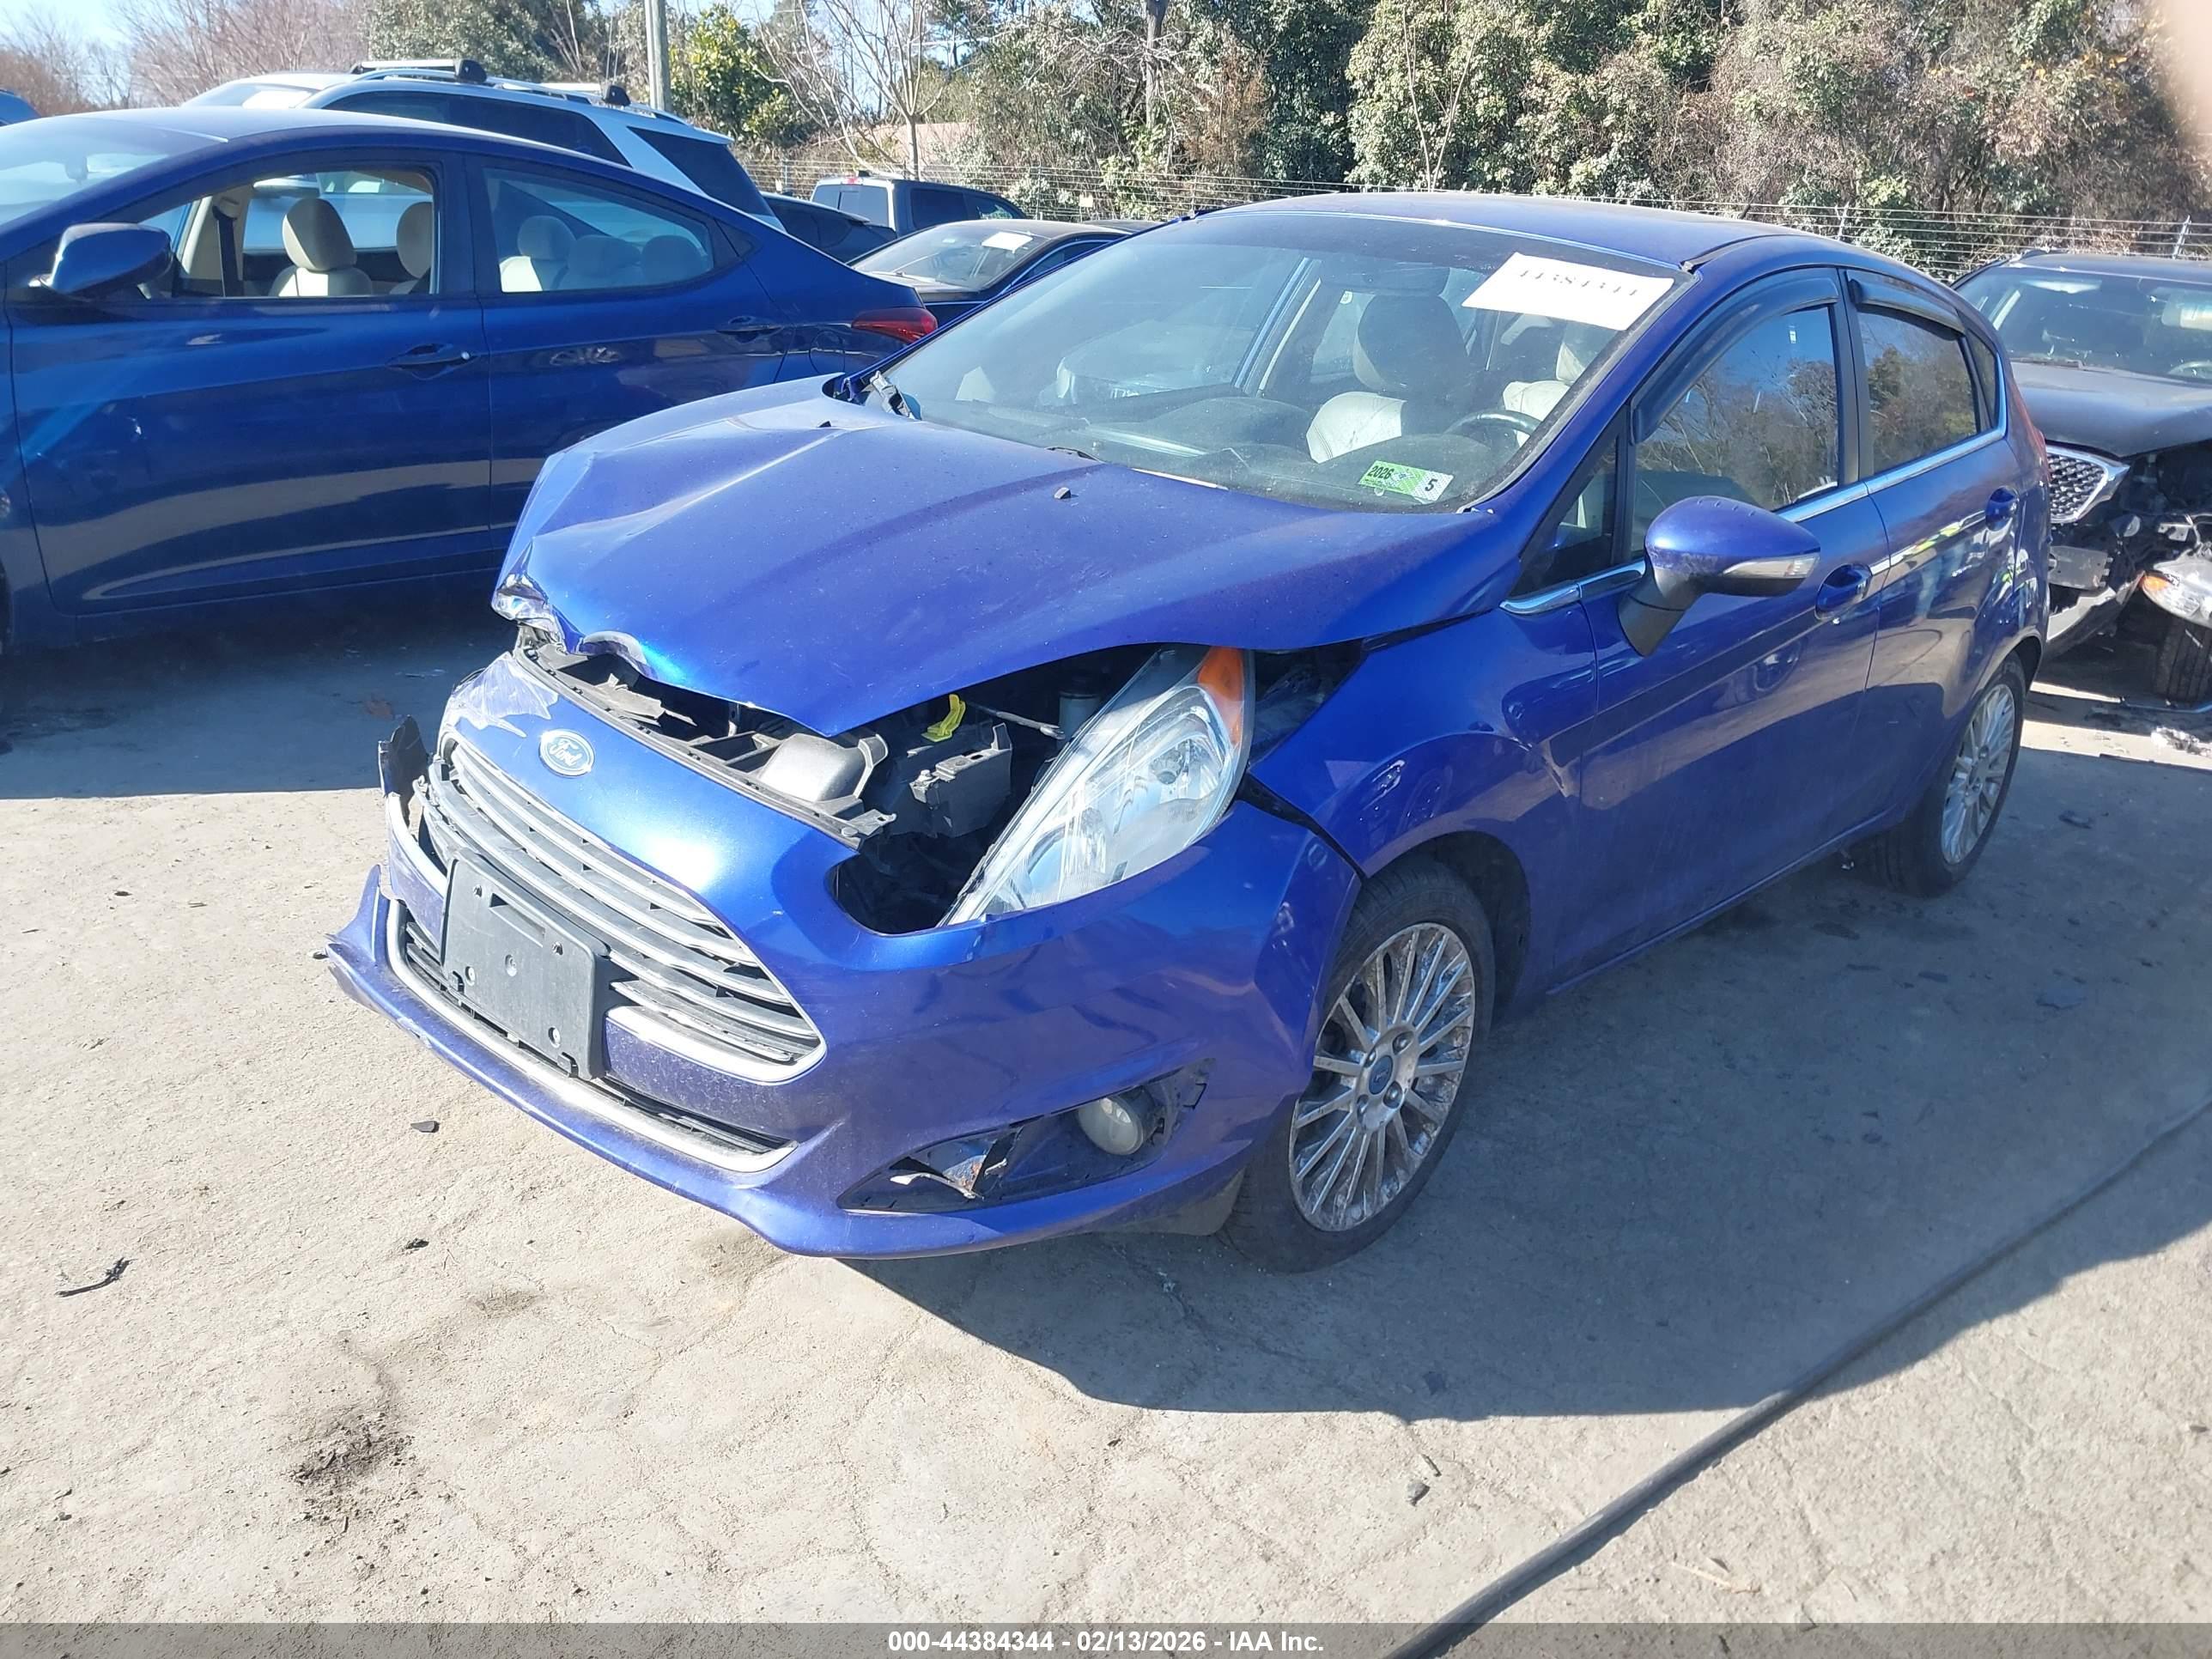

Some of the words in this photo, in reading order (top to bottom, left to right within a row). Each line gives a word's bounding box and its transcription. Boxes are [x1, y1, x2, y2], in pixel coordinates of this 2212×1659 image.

[1367, 465, 1395, 480] 2026
[1425, 478, 1438, 491] 5
[549, 738, 583, 767] Ford
